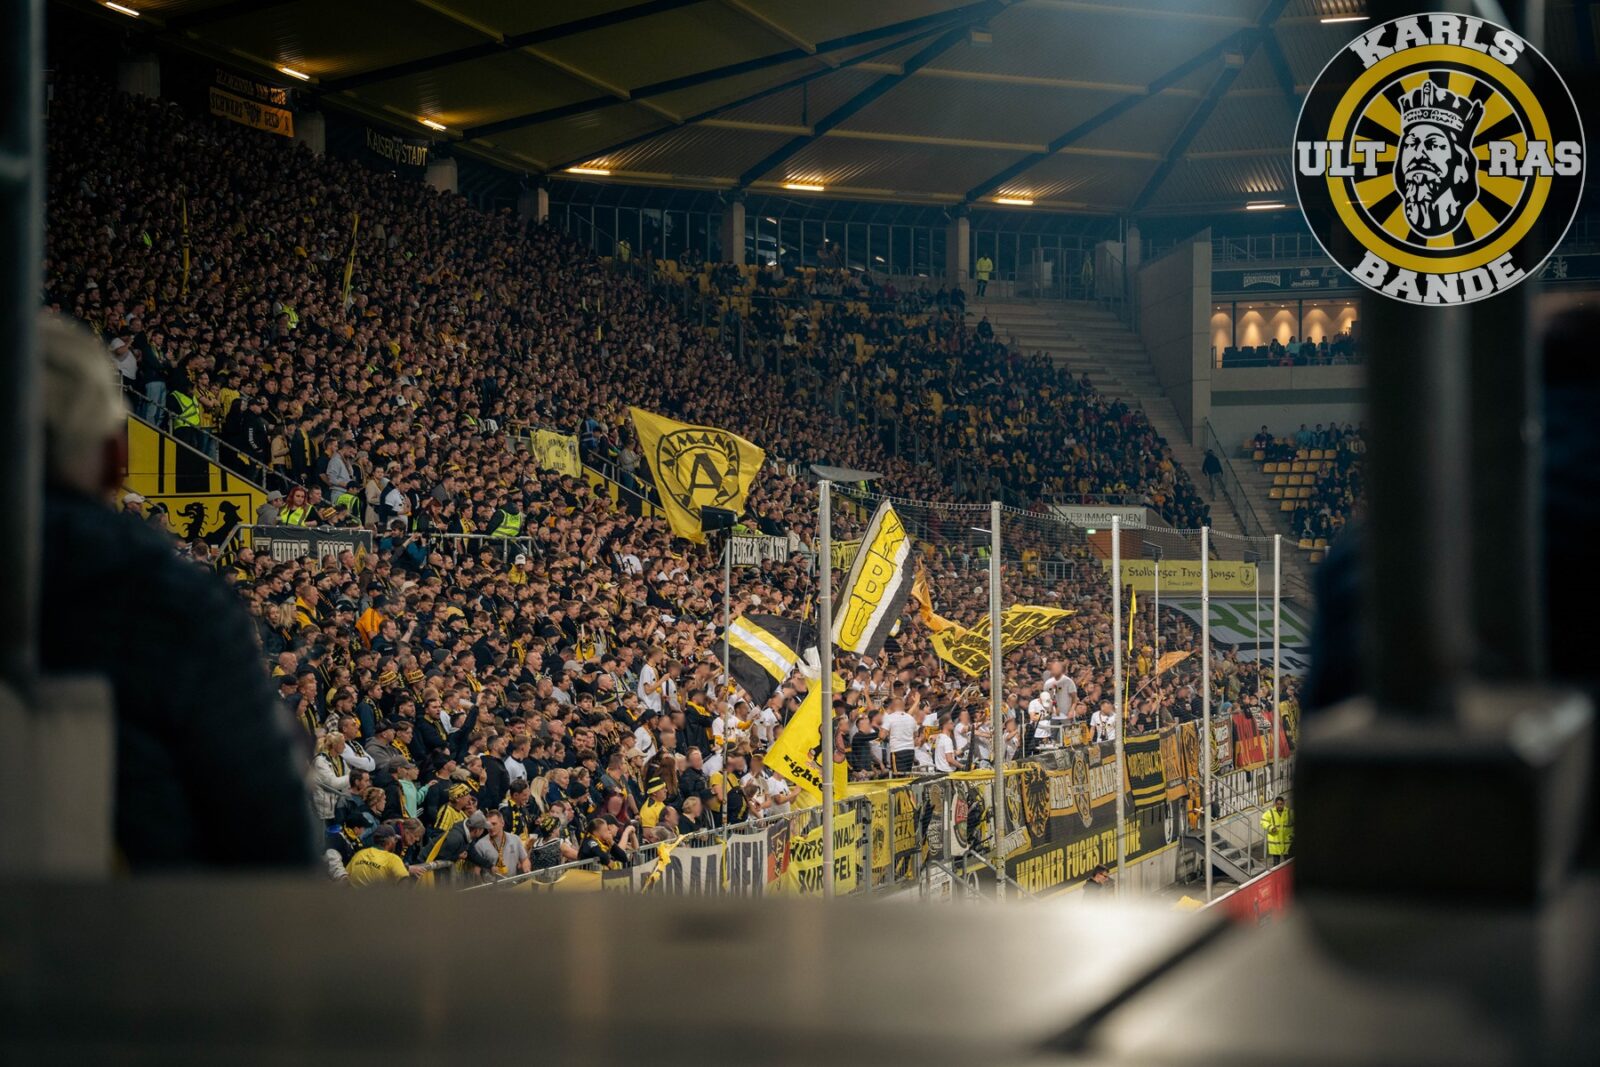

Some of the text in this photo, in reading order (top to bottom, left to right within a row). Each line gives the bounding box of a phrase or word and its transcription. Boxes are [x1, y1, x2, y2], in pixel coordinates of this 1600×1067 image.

[366, 127, 428, 167] KAISER STADT
[687, 452, 724, 498] A
[1084, 512, 1142, 523] IMMOILIEN
[840, 509, 907, 648] KBU
[1016, 848, 1064, 895] WERNER
[1066, 834, 1100, 880] FUCHS
[1101, 817, 1141, 865] TRIÜNE
